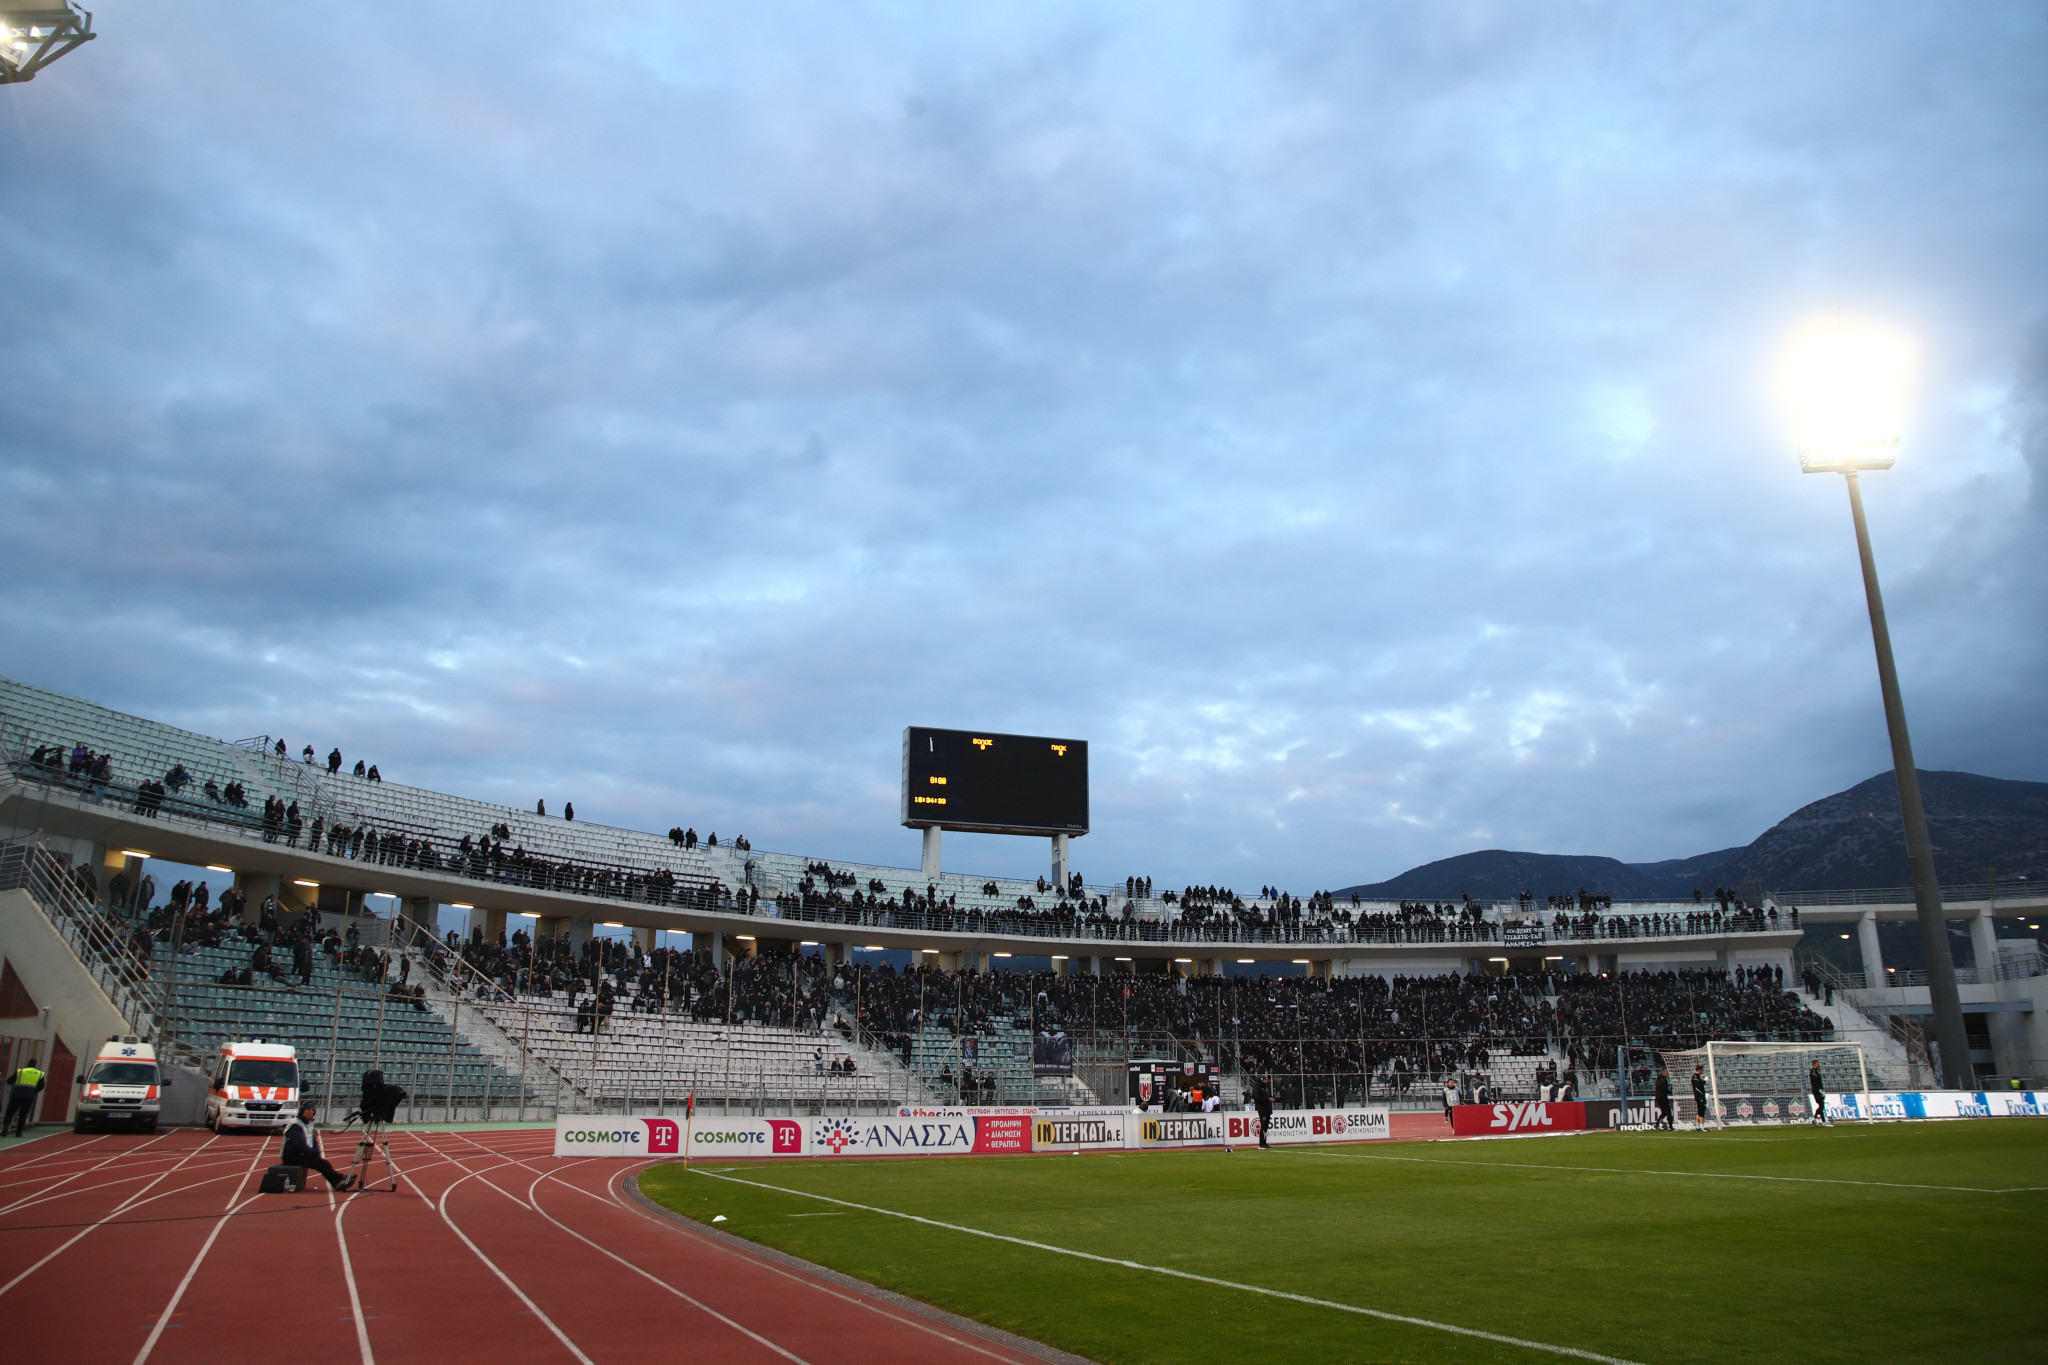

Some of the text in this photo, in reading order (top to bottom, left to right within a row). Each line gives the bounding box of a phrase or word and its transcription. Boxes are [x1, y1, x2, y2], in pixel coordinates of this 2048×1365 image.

[1490, 1103, 1552, 1130] SYM
[1608, 1100, 1681, 1127] novibt
[564, 1130, 640, 1143] COSMOTE
[694, 1132, 765, 1144] COSMOTE
[991, 1130, 1021, 1138] ΔΙΑΓΝΩΣΗ
